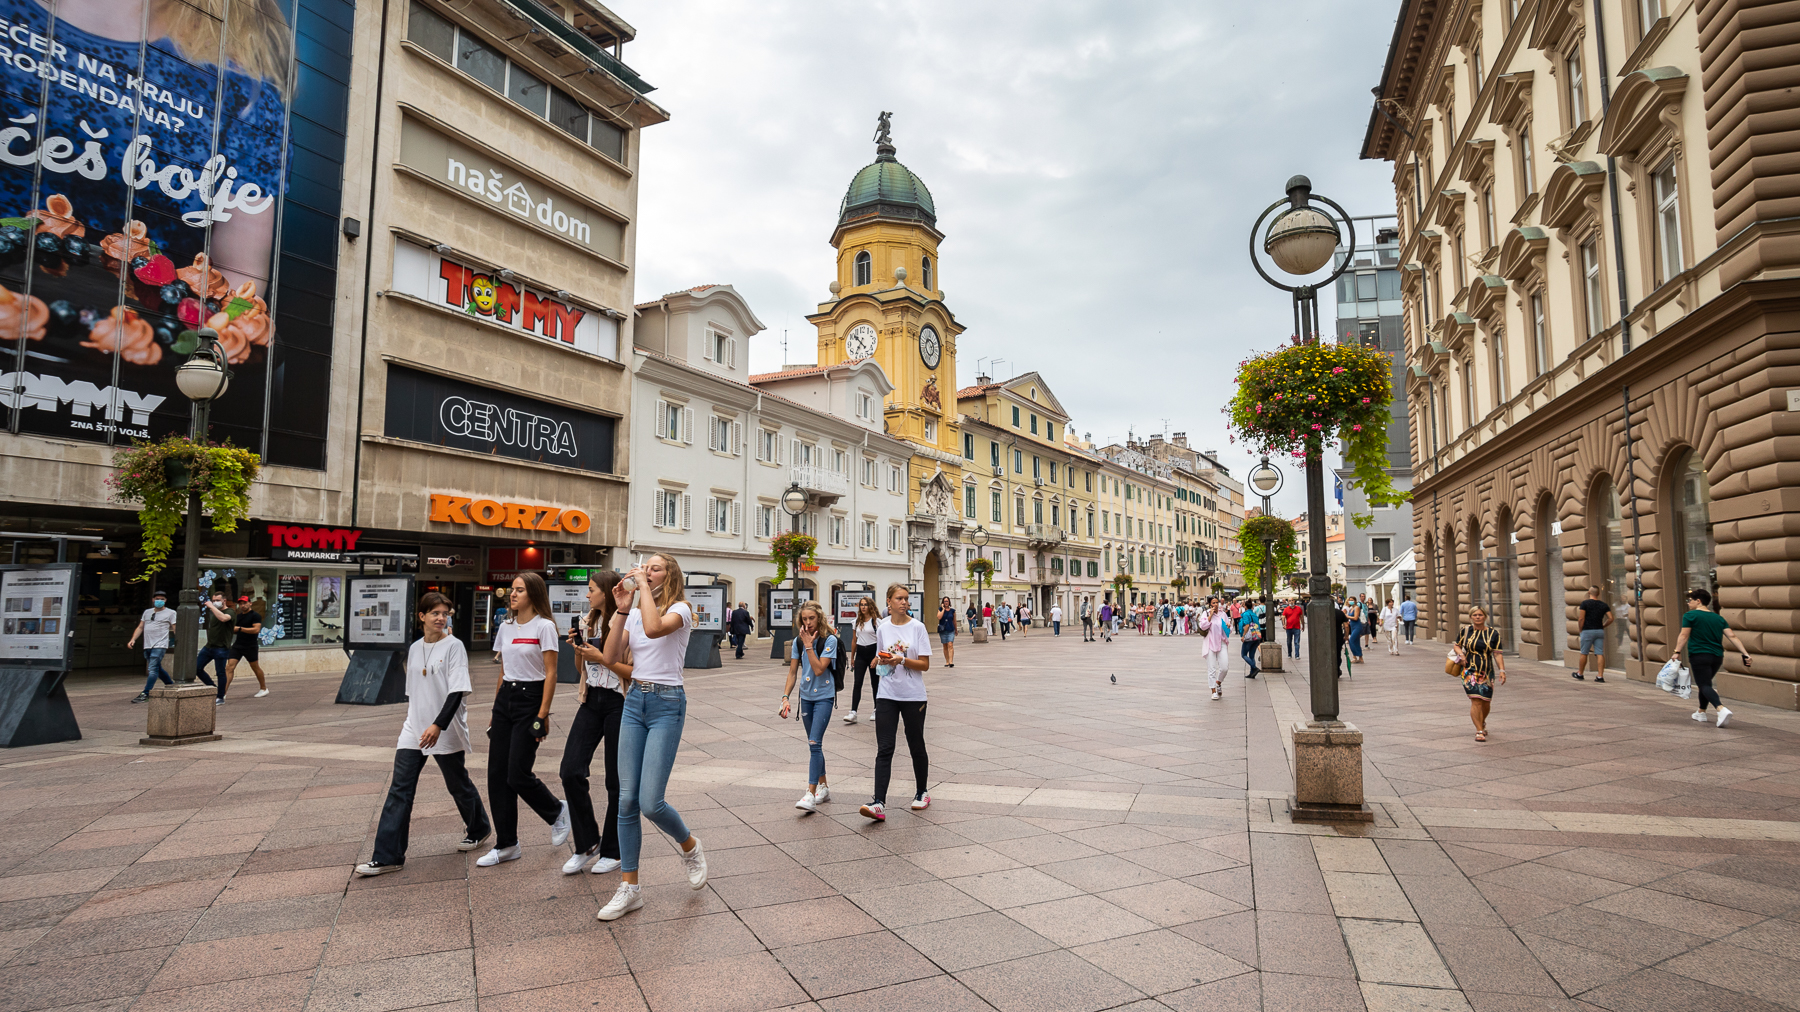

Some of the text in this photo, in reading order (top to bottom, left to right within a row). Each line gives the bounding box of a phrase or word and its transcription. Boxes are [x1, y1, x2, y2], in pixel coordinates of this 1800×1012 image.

[77, 52, 117, 84] NA
[126, 73, 204, 119] KRAJU
[121, 134, 274, 227] bolje
[447, 158, 591, 245] naš dom
[439, 258, 586, 346] TOMMY
[0, 369, 167, 427] OMMY
[439, 395, 578, 459] CENTRA
[70, 420, 94, 431] ZNA
[119, 427, 151, 439] VOLIŠ.
[267, 524, 363, 550] TOMMY
[429, 493, 591, 534] KORZO
[287, 551, 341, 560] MAXIMARKET
